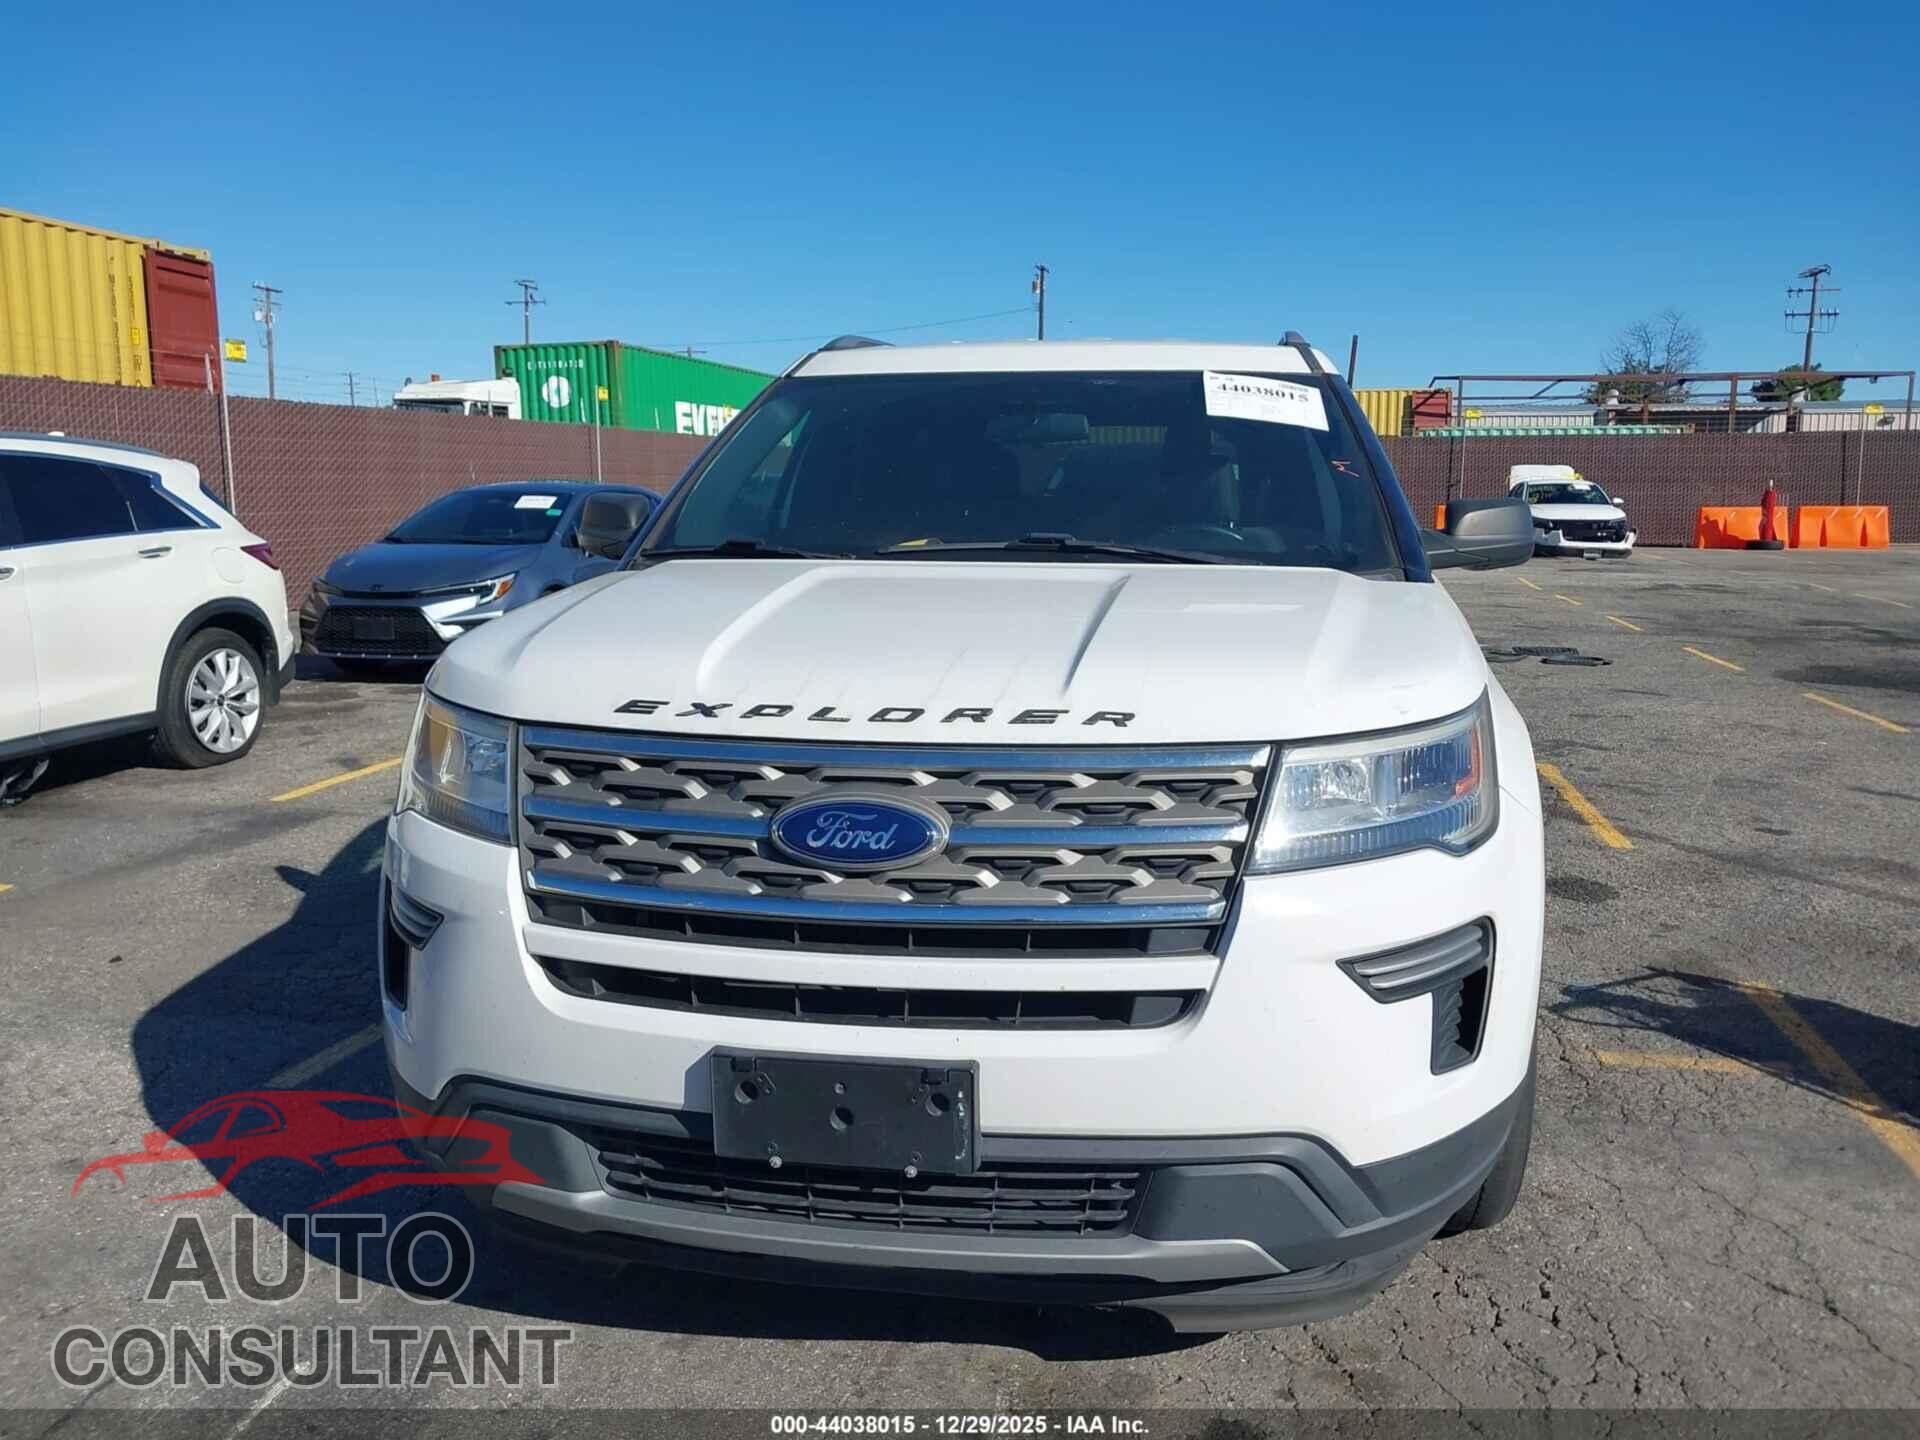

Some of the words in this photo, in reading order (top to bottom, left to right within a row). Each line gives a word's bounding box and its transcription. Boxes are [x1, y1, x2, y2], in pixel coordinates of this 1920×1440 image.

[1216, 383, 1310, 403] 44038015
[612, 698, 1137, 728] EXPLORER
[806, 812, 900, 850] Ford
